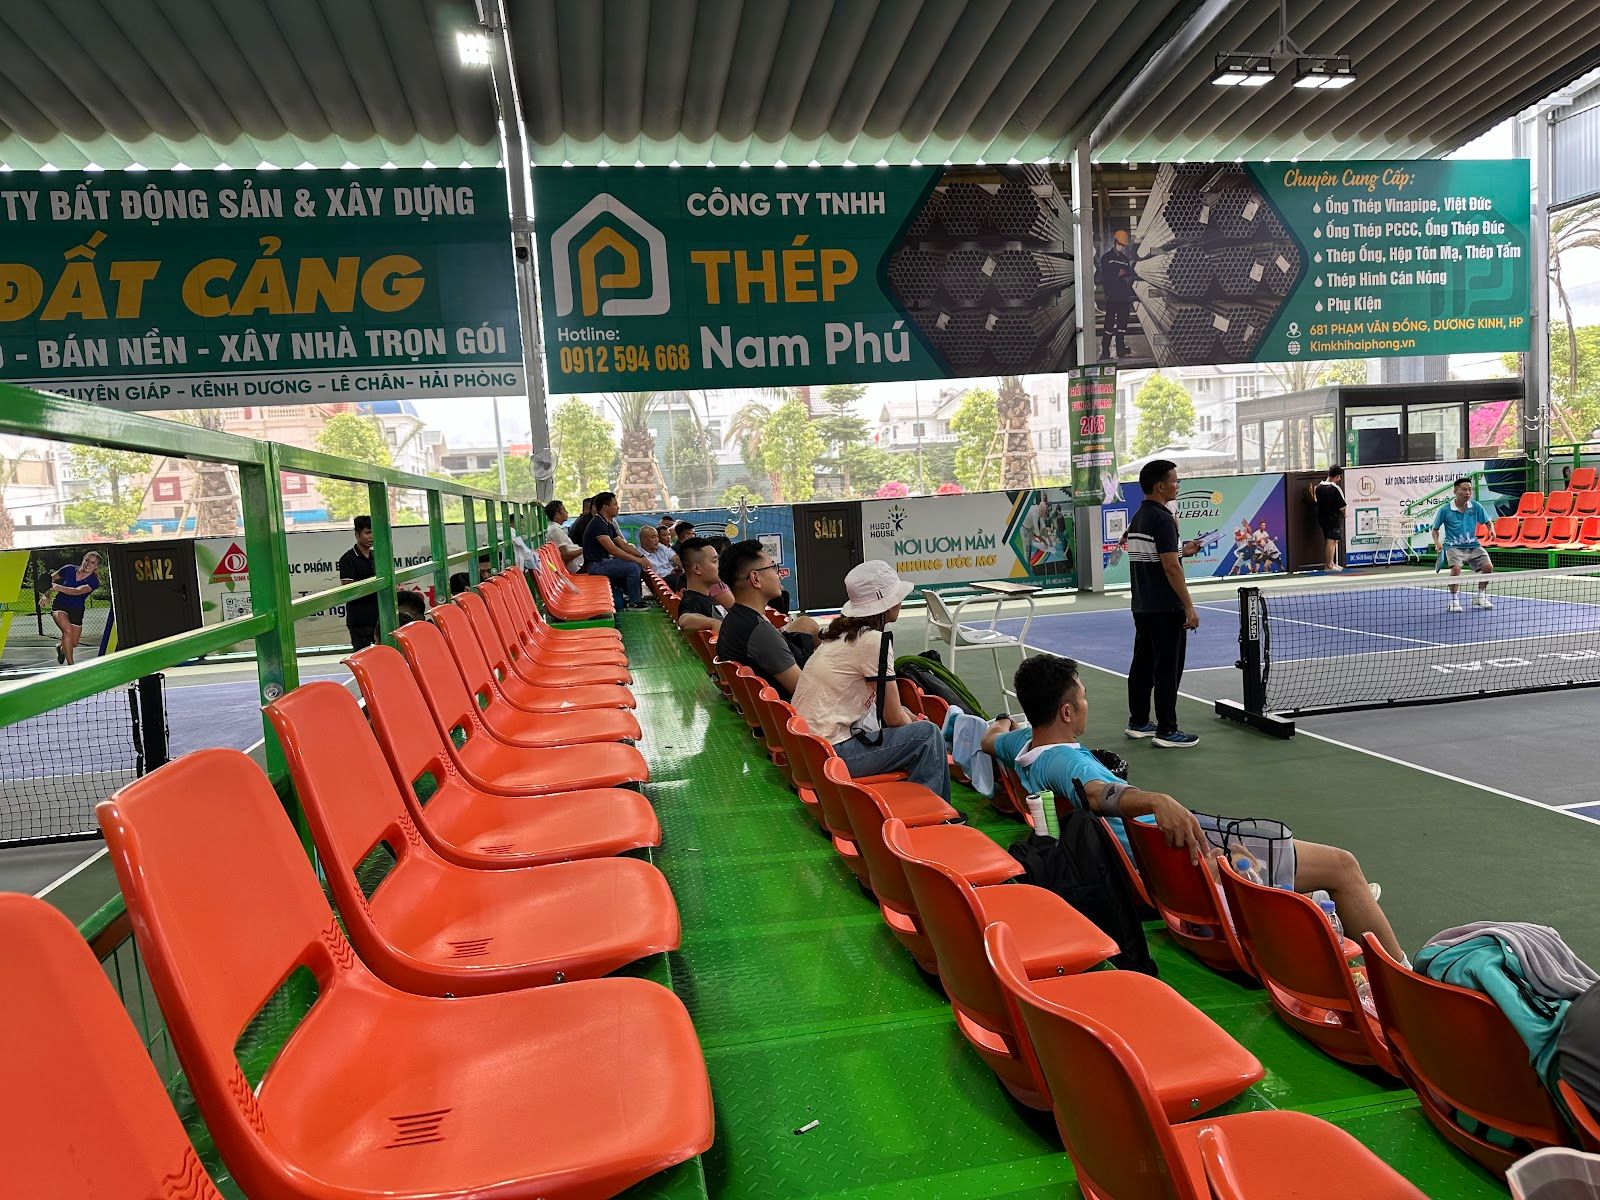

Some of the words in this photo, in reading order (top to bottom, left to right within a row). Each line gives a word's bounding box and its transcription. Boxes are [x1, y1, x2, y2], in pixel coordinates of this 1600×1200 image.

[1283, 169, 1338, 193] Chuyên
[1342, 169, 1379, 193] Cung
[1382, 168, 1415, 191] Cấp:
[2, 190, 38, 221] TY
[51, 179, 110, 221] BẤT
[121, 184, 208, 226] ĐỘNG
[219, 179, 283, 218] SẢN
[294, 190, 316, 218] &
[327, 182, 384, 217] XÂY
[394, 184, 474, 221] DỰNG
[686, 187, 771, 217] CÔNG
[776, 193, 810, 215] TY
[816, 191, 886, 215] TNHH
[1325, 195, 1349, 215] Ống
[1352, 198, 1382, 214] Thép
[1385, 198, 1441, 214] Vinapipe,
[1444, 197, 1467, 212] Việt
[1469, 196, 1492, 211] Đức
[1326, 221, 1350, 240] Ống
[1353, 223, 1382, 239] Thép
[1386, 222, 1422, 238] PCCC,
[1425, 218, 1448, 237] Ống
[1451, 221, 1479, 237] Thép
[1482, 219, 1505, 235] Đúc
[1326, 247, 1355, 264] Thép
[1359, 243, 1387, 263] Ống,
[1389, 247, 1412, 263] Hộp
[1415, 245, 1437, 260] Tôn
[1440, 246, 1462, 262] Mạ,
[1465, 244, 1494, 260] Thép
[1496, 241, 1521, 258] Tấm
[0, 230, 161, 322] ĐẤT
[181, 236, 424, 317] CẢNG
[690, 234, 859, 305] THÉP
[1327, 272, 1357, 289] Thép
[1360, 271, 1386, 286] Hình
[1390, 271, 1413, 286] Cán
[1416, 271, 1447, 286] Nóng
[1327, 297, 1350, 314] Phụ
[1354, 296, 1382, 313] Kiện
[557, 327, 621, 342] Hotline:
[1310, 325, 1328, 336] 681
[1331, 323, 1364, 337] PHẠM
[1366, 320, 1389, 334] VĂN
[1392, 317, 1430, 333] ĐỒNG,
[1433, 317, 1475, 331] DƯƠNG
[1478, 318, 1506, 330] KINH,
[1509, 317, 1523, 328] HP
[39, 332, 112, 369] BÁN
[118, 328, 187, 366] NỀN
[221, 329, 281, 363] XÂY
[292, 325, 357, 359] NHÀ
[365, 328, 445, 363] TRỌN
[457, 322, 505, 355] GÓI
[700, 325, 810, 369] Nam
[824, 320, 911, 365] Phú
[1310, 338, 1416, 354] Kimkhihaiphong.vn
[560, 346, 609, 374] 0912
[614, 345, 650, 372] 594
[655, 344, 690, 371] 668
[125, 382, 171, 400] GIÁP
[191, 380, 238, 398] KÊNH
[245, 378, 312, 396] DƯƠNG
[331, 375, 351, 392] LÊ
[419, 369, 449, 389] HẢI
[452, 371, 517, 388] PHÒNG
[814, 516, 837, 539] SÂN
[870, 522, 890, 530] HUGO
[870, 530, 895, 538] HOUSE
[135, 555, 163, 581] SÂN
